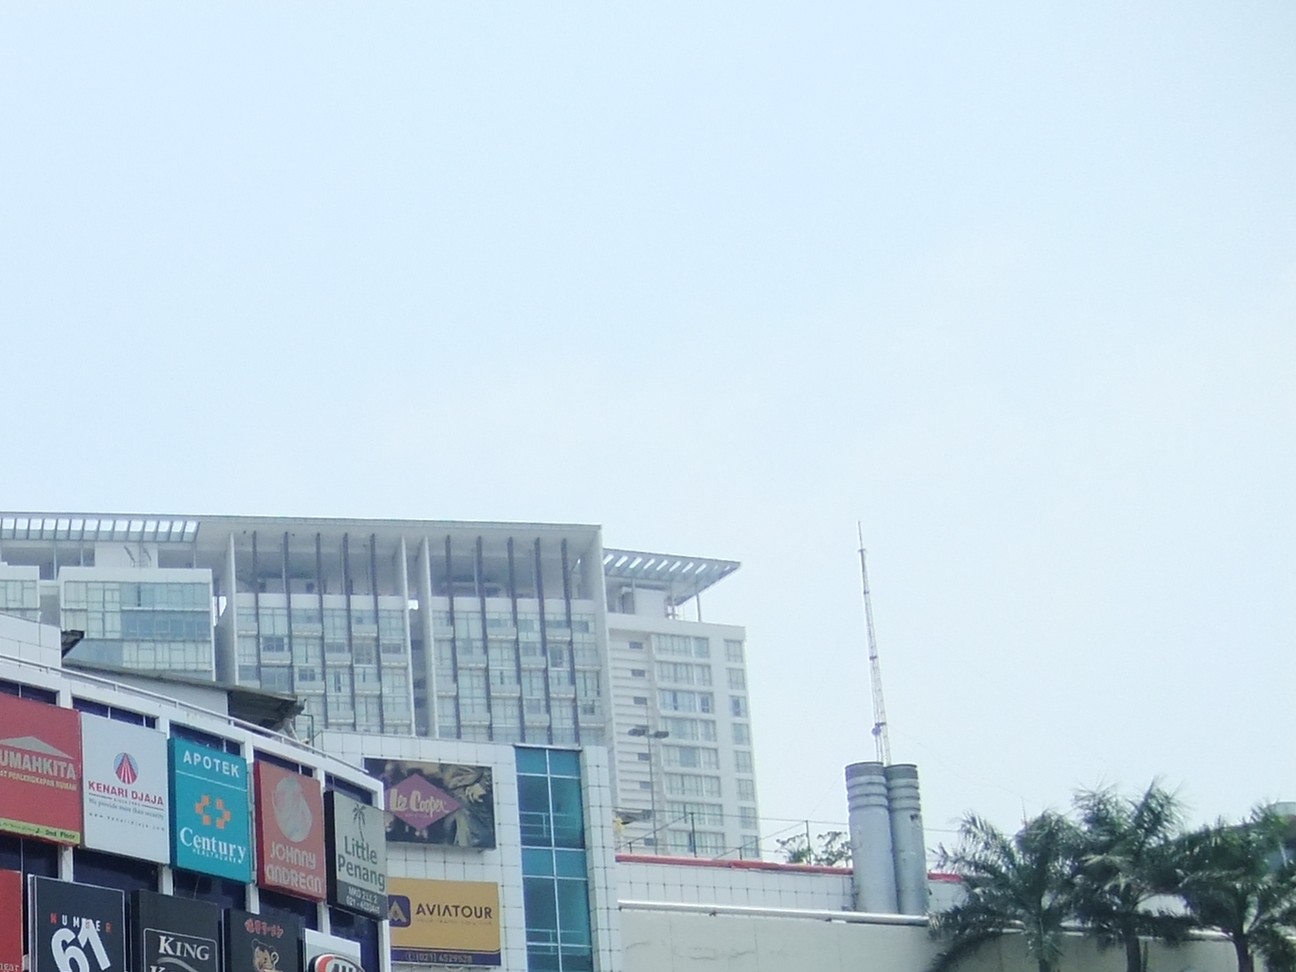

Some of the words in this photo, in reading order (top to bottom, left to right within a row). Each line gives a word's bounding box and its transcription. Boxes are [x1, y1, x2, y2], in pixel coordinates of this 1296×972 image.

[183, 750, 240, 778] APOTEK
[88, 780, 128, 798] KENARI
[131, 790, 164, 806] DJAJA
[180, 827, 246, 864] Century
[344, 835, 378, 865] Little
[338, 854, 385, 891] Penang
[416, 903, 492, 919] AVIATOUR
[158, 935, 210, 961] KING
